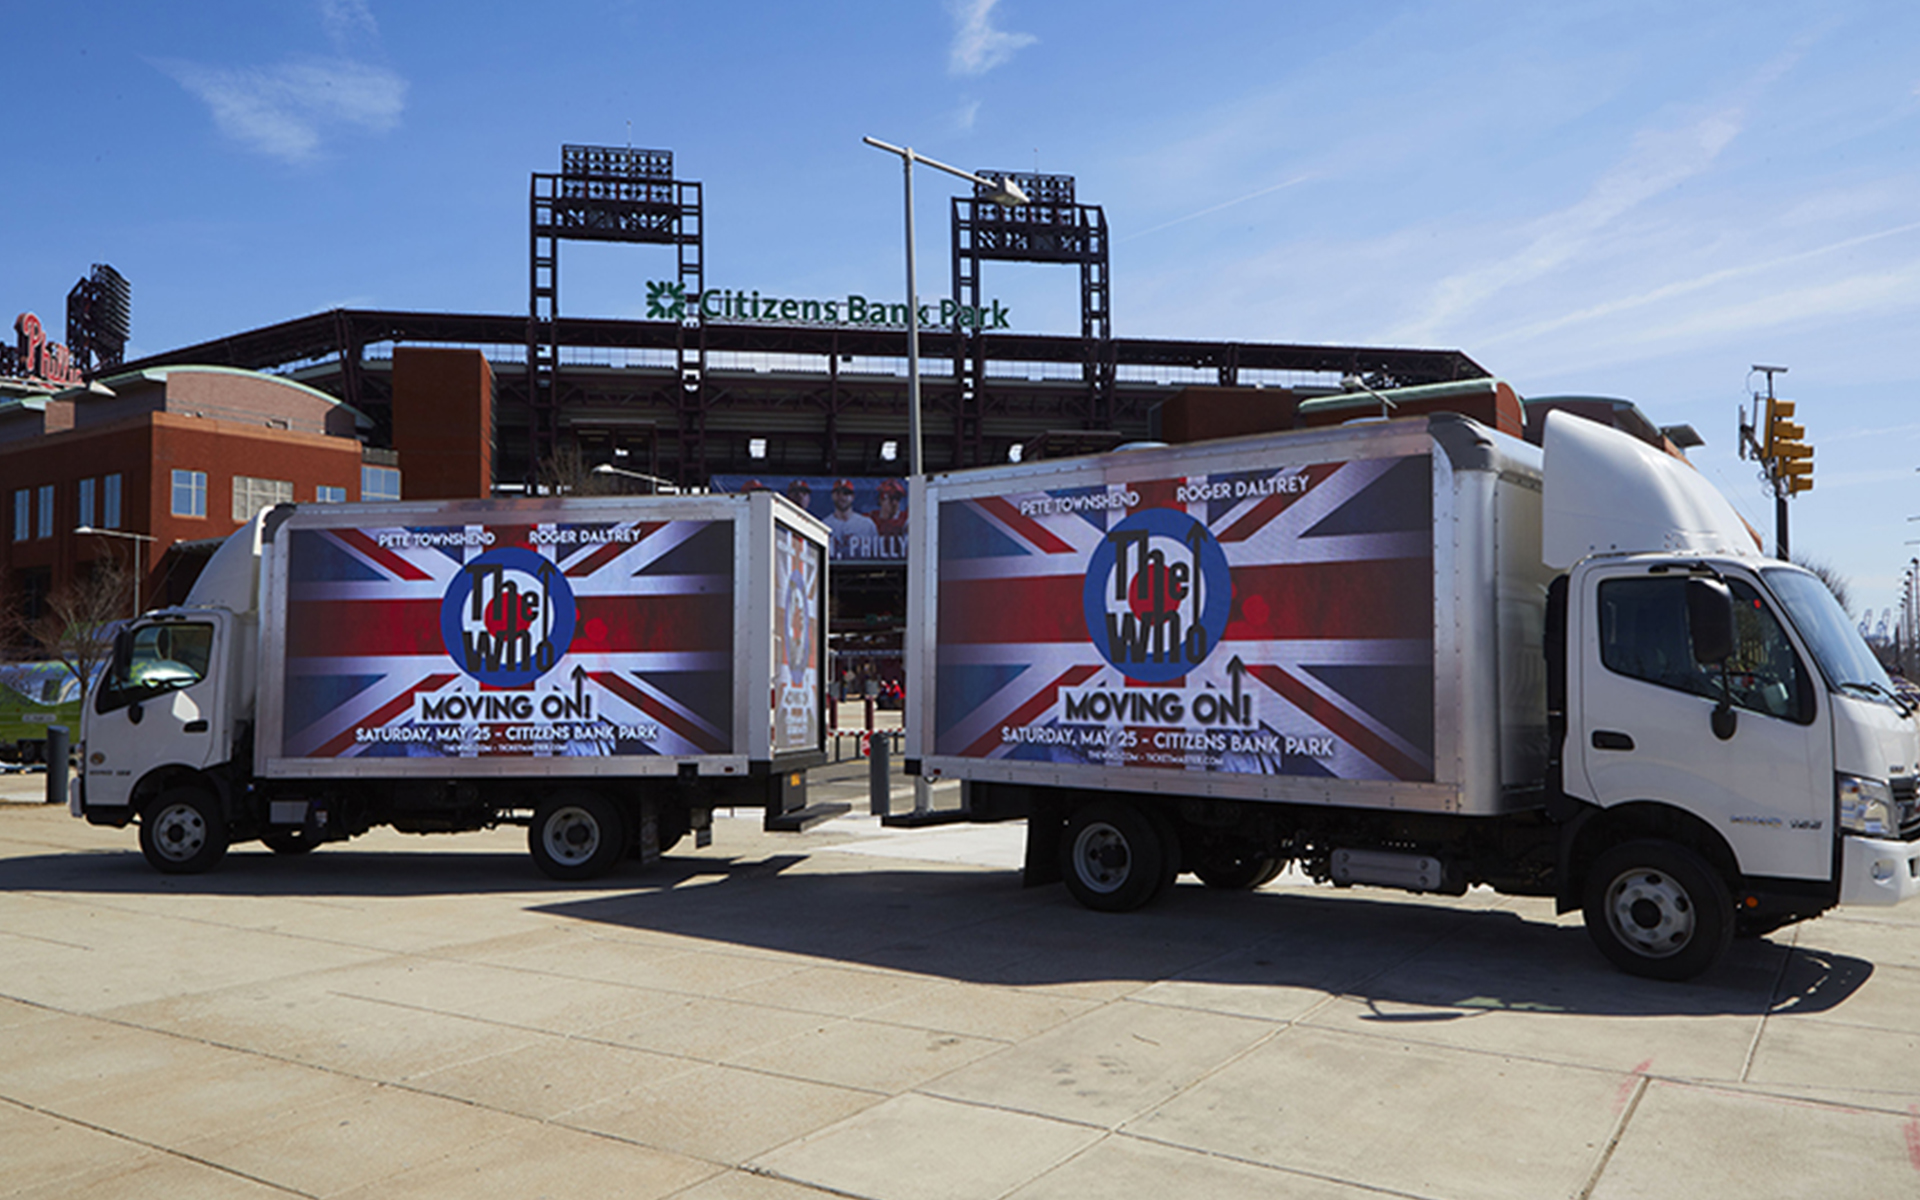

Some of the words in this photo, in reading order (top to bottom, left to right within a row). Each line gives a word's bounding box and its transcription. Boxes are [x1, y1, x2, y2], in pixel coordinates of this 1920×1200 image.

[701, 288, 838, 322] Citizens
[847, 295, 930, 325] Bank
[939, 298, 1011, 329] Park
[1020, 502, 1051, 516] PETE
[1056, 491, 1141, 511] TOWNSHEND
[1176, 484, 1232, 503] ROGER
[1236, 475, 1309, 497] DALTREY
[379, 533, 410, 547] PETE
[413, 531, 496, 547] TOWNSHEND
[529, 530, 577, 545] ROGER
[581, 528, 641, 543] DALTREY
[850, 535, 907, 558] PHILLY
[1108, 529, 1190, 601] The
[465, 564, 540, 621] The
[462, 629, 555, 674] Who
[1105, 611, 1207, 665] Who
[421, 695, 534, 720] MOVING
[541, 694, 592, 720] ON!
[1065, 691, 1185, 724] MOVING
[1192, 692, 1252, 726] ON!
[355, 727, 433, 742] SATURDAY,
[436, 728, 467, 741] MAY
[473, 727, 492, 741] 25
[505, 726, 570, 741] CITIZENS
[573, 726, 615, 740] BANK
[619, 725, 658, 740] PARK
[1001, 726, 1077, 746] SATURDAY,
[1080, 730, 1112, 745] MAY
[1118, 731, 1138, 747] 25
[1153, 731, 1227, 751] CITIZENS
[1231, 735, 1281, 754] BANK
[1284, 737, 1334, 757] PARK
